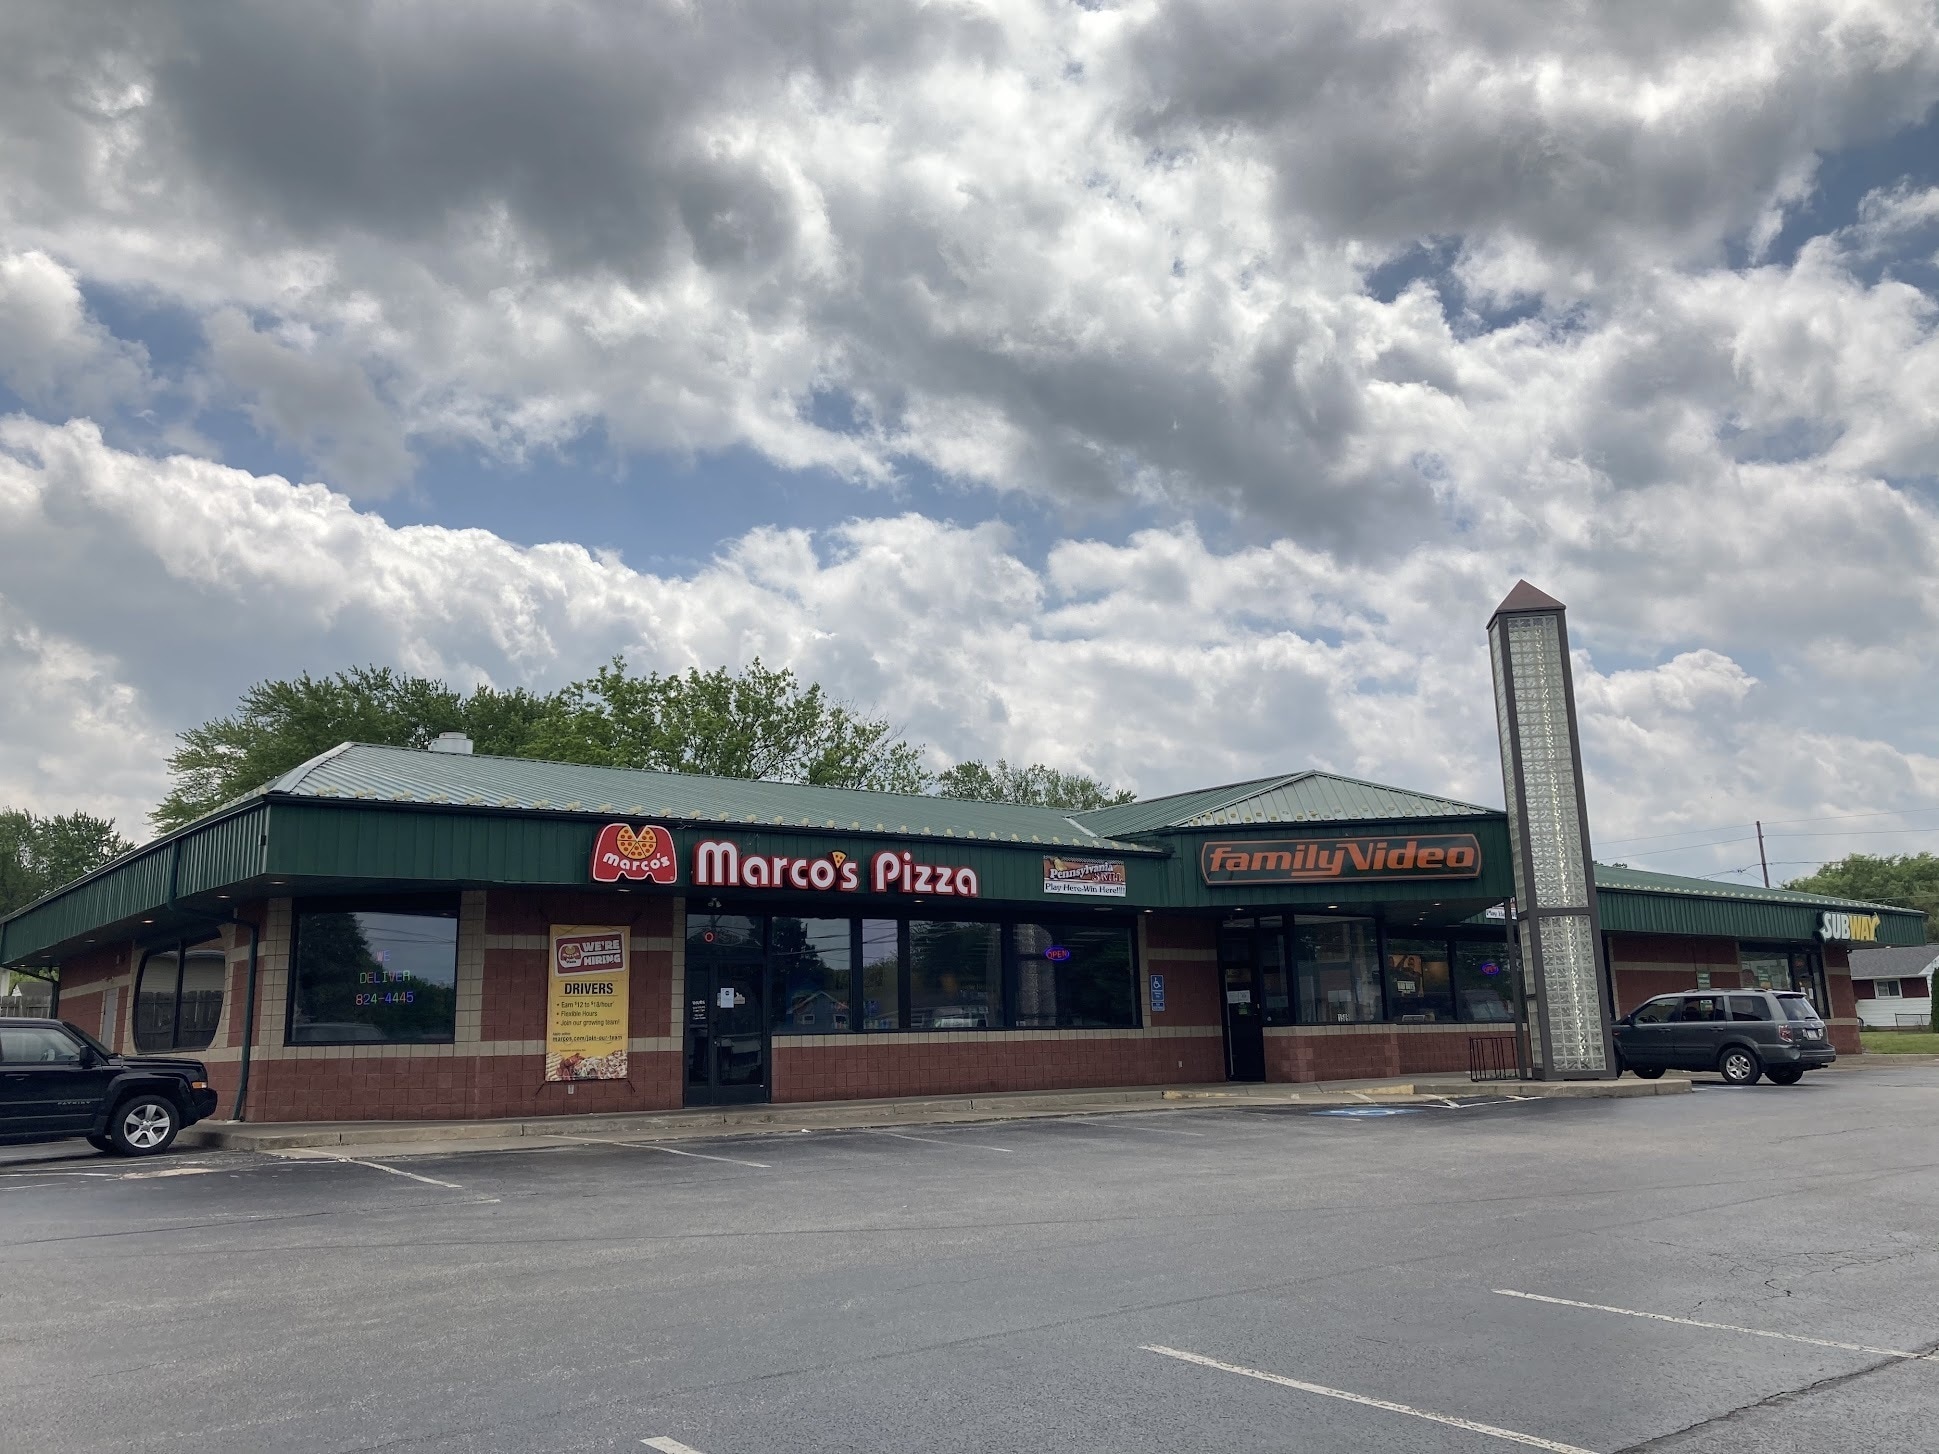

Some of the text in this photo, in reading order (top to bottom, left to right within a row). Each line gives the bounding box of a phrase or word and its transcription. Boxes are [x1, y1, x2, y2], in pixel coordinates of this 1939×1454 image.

[602, 852, 671, 871] marco's
[694, 840, 979, 897] Marco's Pizza
[1049, 862, 1114, 879] Pennsylvania
[1045, 882, 1062, 892] Play
[1820, 911, 1881, 942] SUBWAY
[582, 940, 620, 952] WE'RE
[376, 949, 391, 962] WE
[584, 954, 621, 966] HIRING
[1047, 950, 1068, 960] OPEN
[360, 969, 411, 984] DELIVER
[564, 982, 614, 995] DRIVERS
[355, 991, 414, 1006] 824-4445
[583, 1019, 605, 1027] growing
